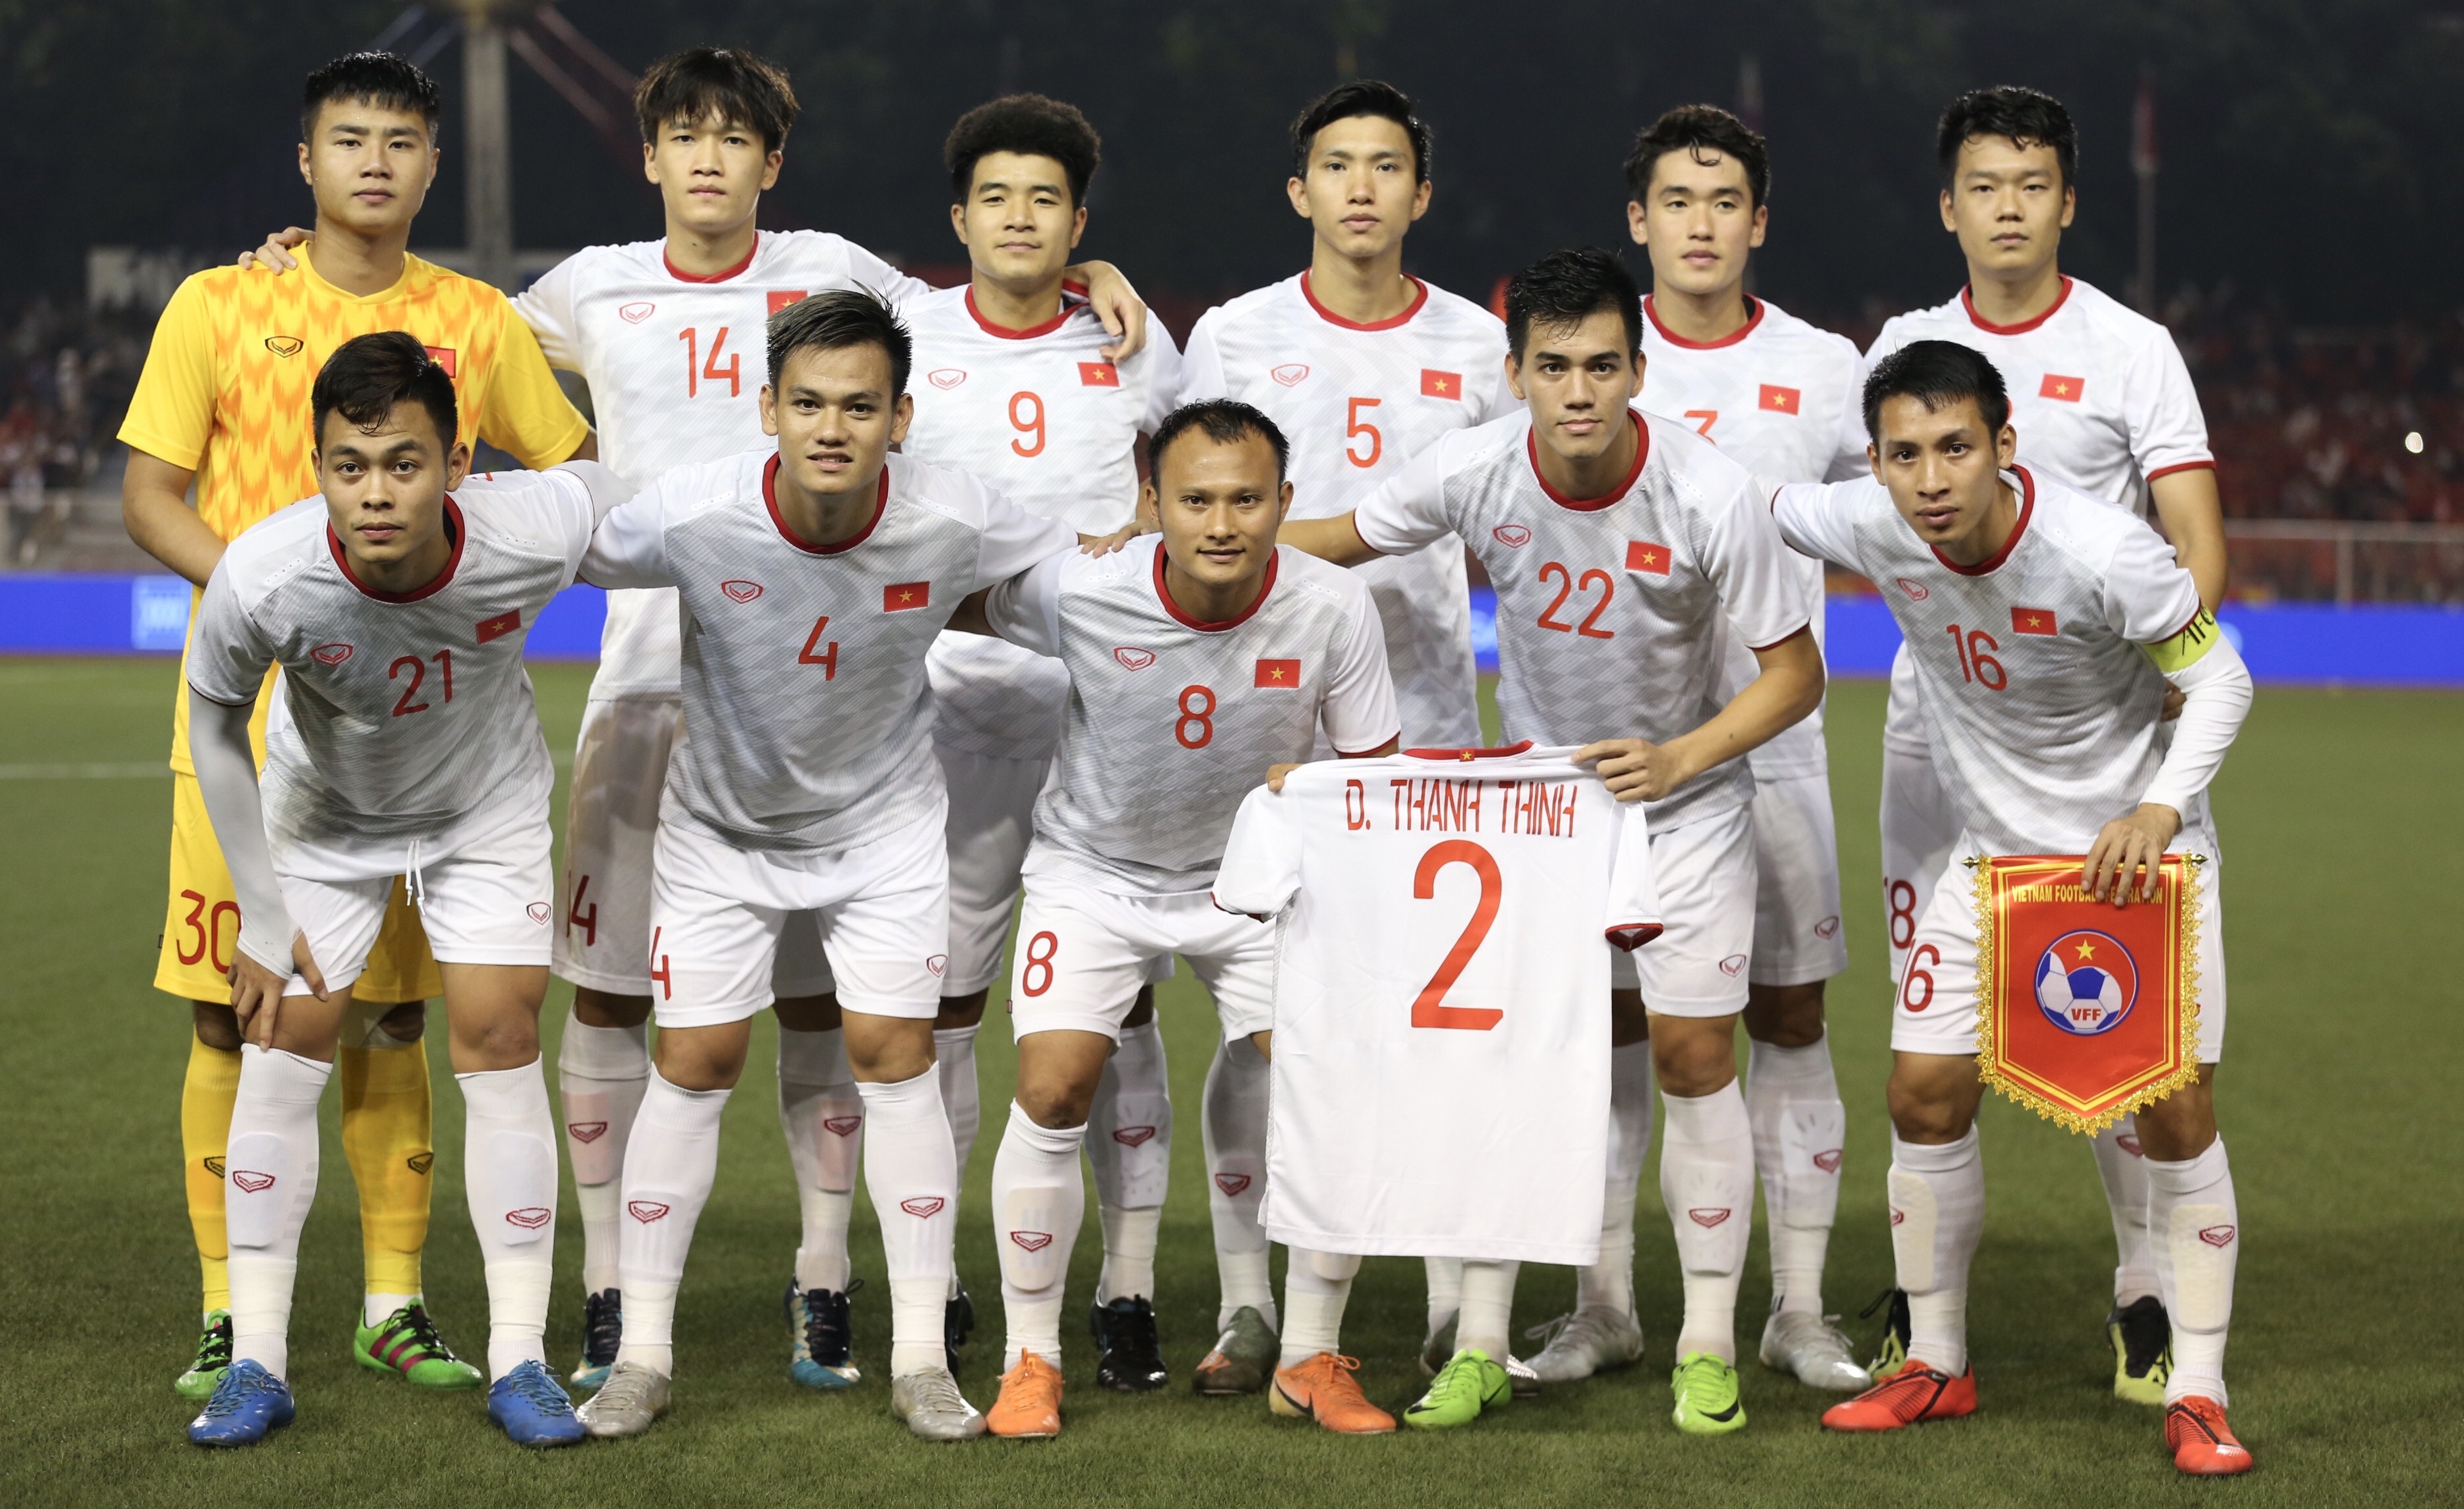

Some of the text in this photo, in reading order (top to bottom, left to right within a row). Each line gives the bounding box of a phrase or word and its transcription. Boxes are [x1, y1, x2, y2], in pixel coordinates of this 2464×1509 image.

[679, 327, 741, 398] 14
[1008, 391, 1046, 458] 9
[1346, 397, 1382, 468] 5
[1538, 561, 1615, 639] 22
[798, 616, 839, 681] 4
[1946, 624, 2008, 691] 16
[388, 649, 452, 717] 21
[1175, 684, 1217, 750] 8
[1345, 778, 1578, 837] D. THANH THINH
[2011, 885, 2053, 903] VIETNAM
[2056, 885, 2101, 903] FOOTBAL
[175, 888, 242, 975] 30
[650, 925, 672, 1001] 4
[1022, 931, 1059, 997] 8
[1410, 839, 1503, 1032] 2
[2071, 1008, 2102, 1021] VFF
